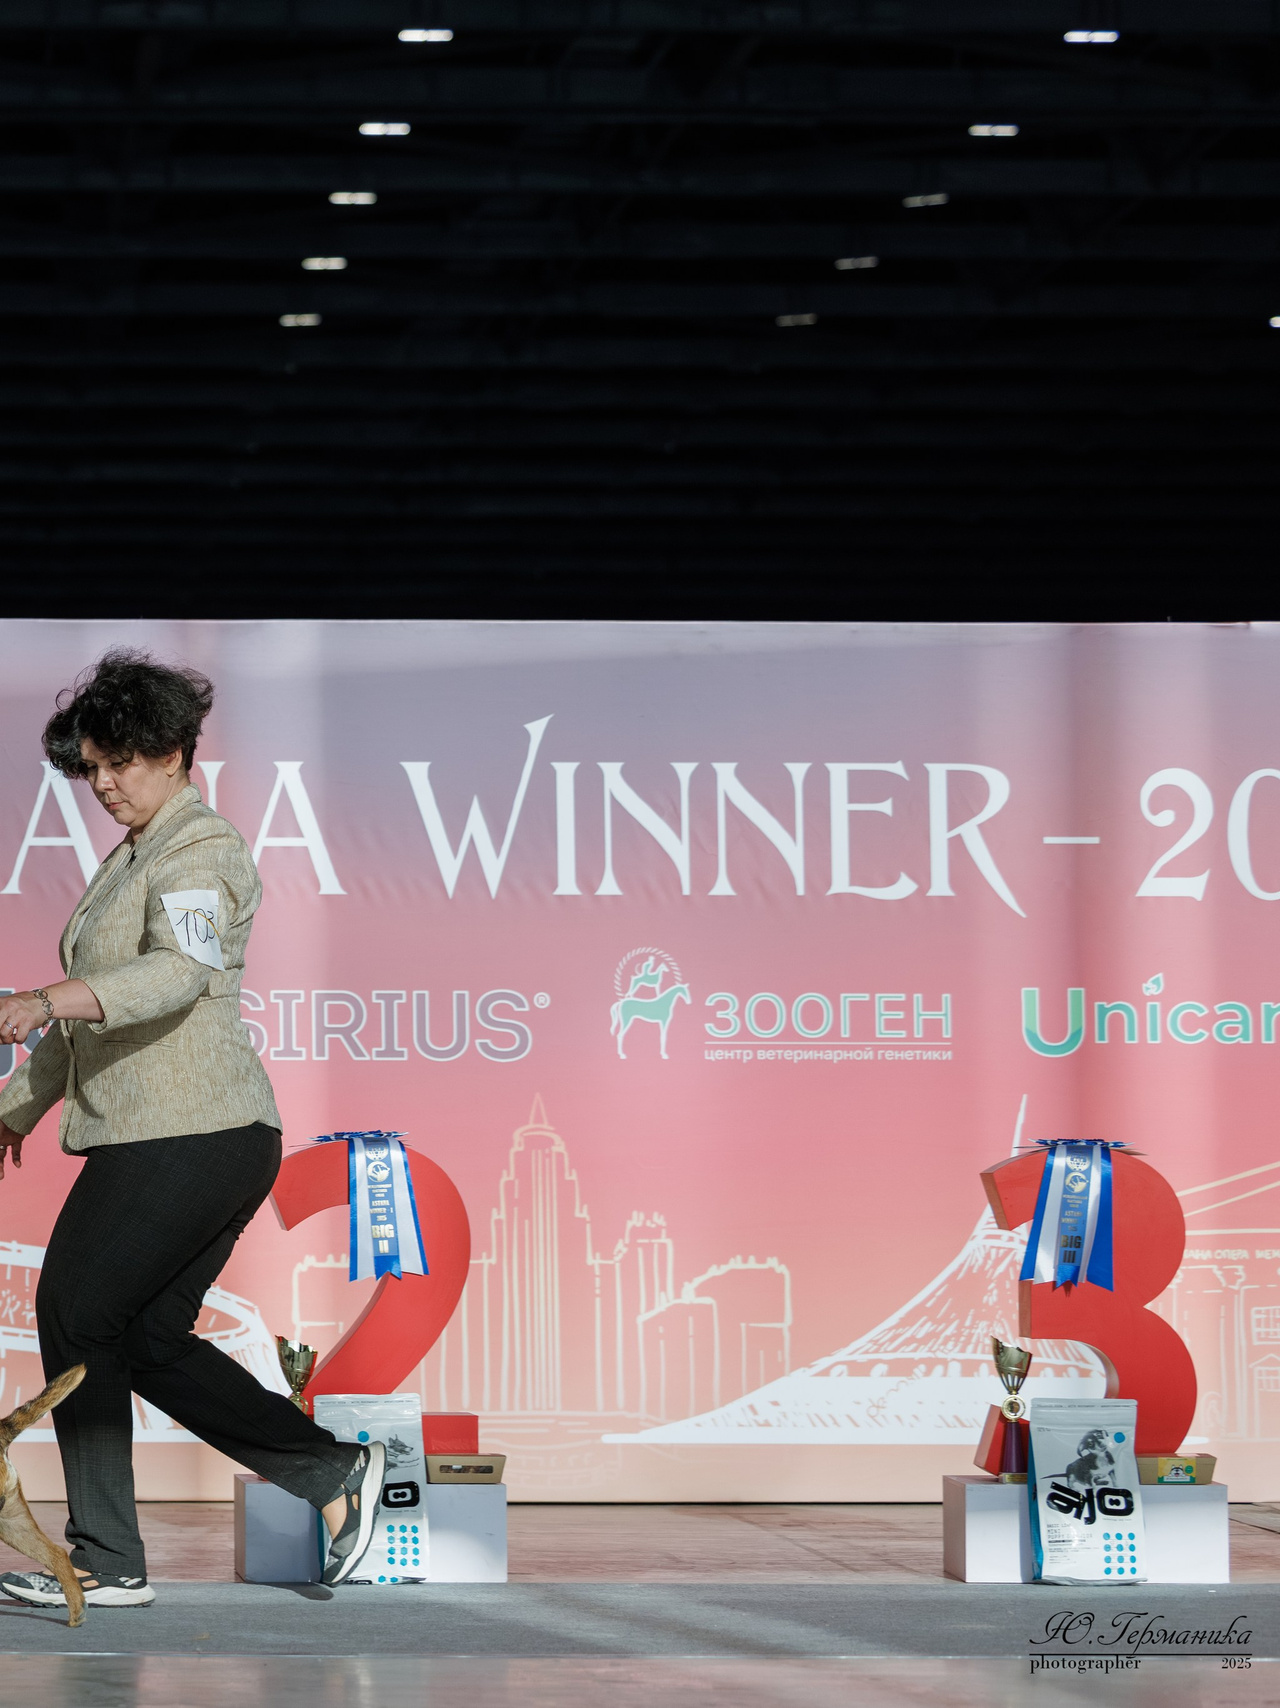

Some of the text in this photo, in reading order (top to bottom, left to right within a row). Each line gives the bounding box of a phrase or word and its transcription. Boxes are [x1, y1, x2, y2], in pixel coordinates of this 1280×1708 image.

[399, 713, 1027, 918] WINNER
[1134, 768, 1280, 901] 20
[176, 908, 216, 946] 103
[704, 992, 952, 1038] ЗООГЕН
[704, 1047, 952, 1063] центр ветеринарной генетики
[371, 1224, 395, 1238] BIG
[378, 1240, 389, 1254] II
[1060, 1235, 1082, 1249] BIG
[1062, 1250, 1076, 1263] III
